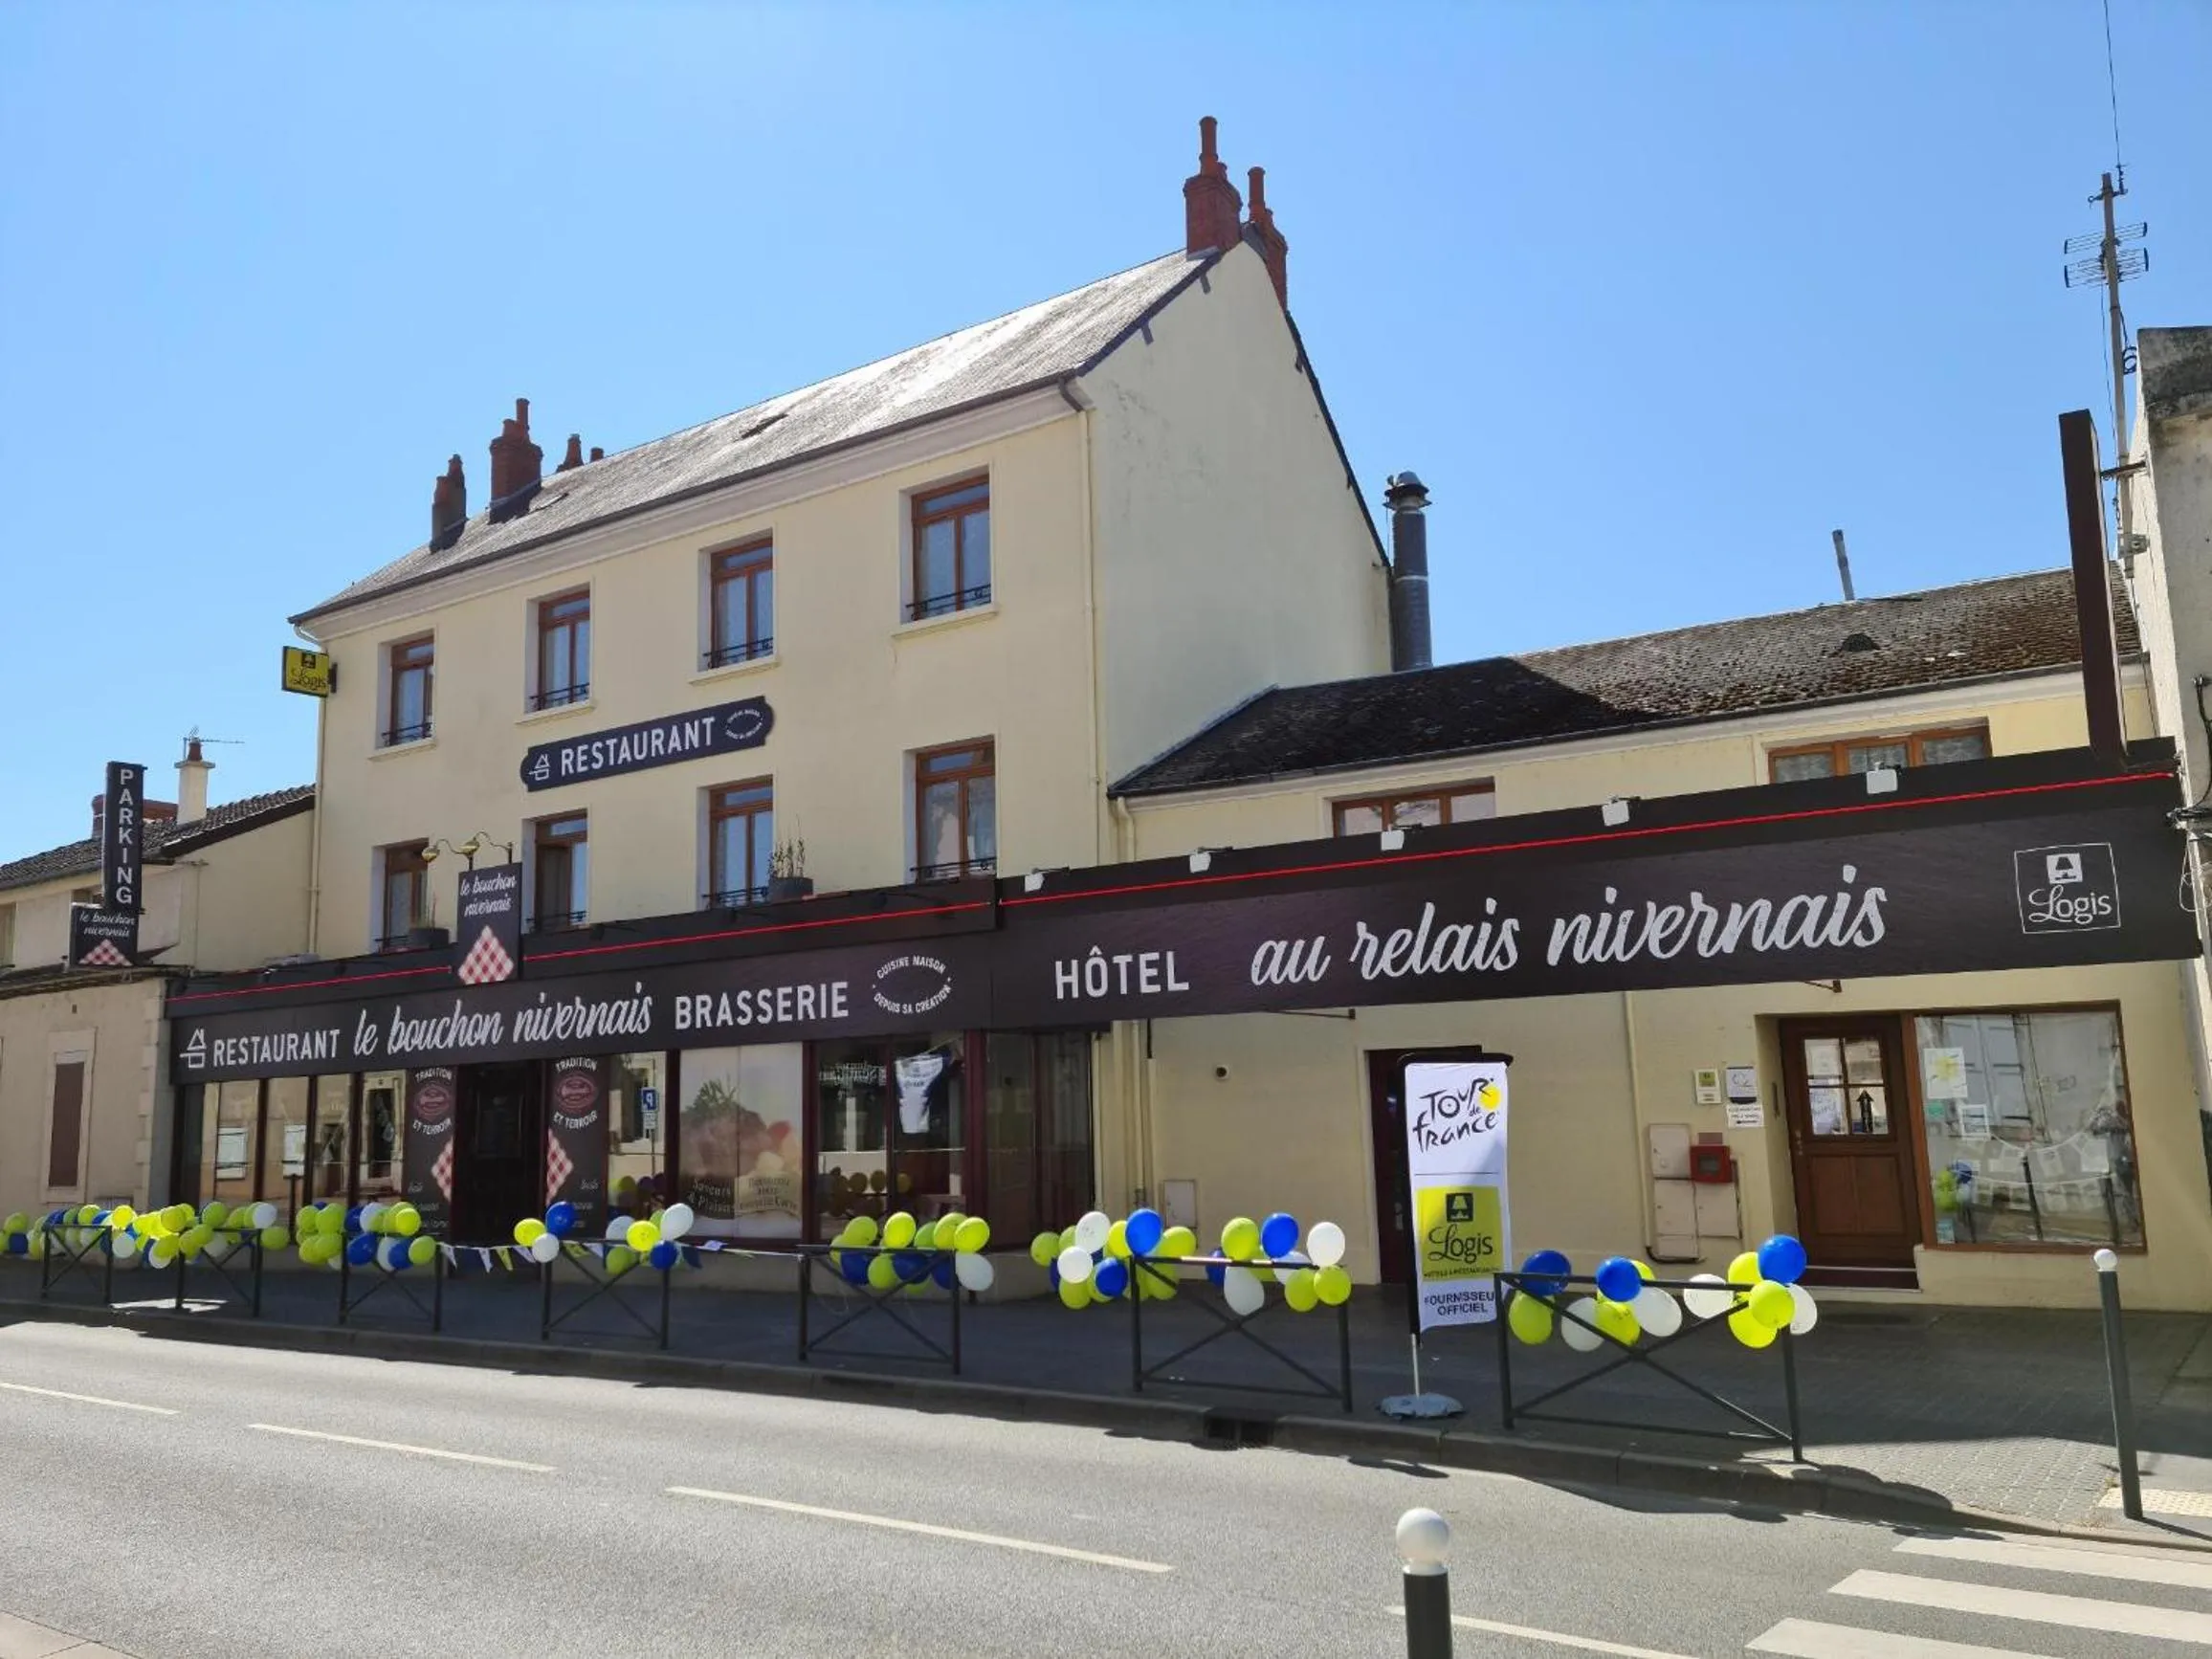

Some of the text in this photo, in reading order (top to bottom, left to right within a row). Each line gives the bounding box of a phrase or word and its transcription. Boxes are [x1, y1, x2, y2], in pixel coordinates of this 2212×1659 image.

[561, 717, 715, 777] RESTAURANT
[116, 769, 134, 905] PARKING
[460, 873, 517, 896] le bouchon
[464, 893, 511, 918] nivernais
[2028, 885, 2112, 924] Logis
[1054, 864, 1888, 999] HÔTEL au relais nivernais
[876, 955, 946, 979] CUISINE MAISON
[901, 1004, 914, 1014] SA
[213, 981, 849, 1068] RESTAURANT le bouchon nivernais BRASSERIE
[556, 1056, 597, 1073] TRADITION
[1427, 1223, 1493, 1264] Logis
[1424, 1291, 1494, 1305] FOURNISSEU
[1437, 1301, 1489, 1316] OFFICIEL
